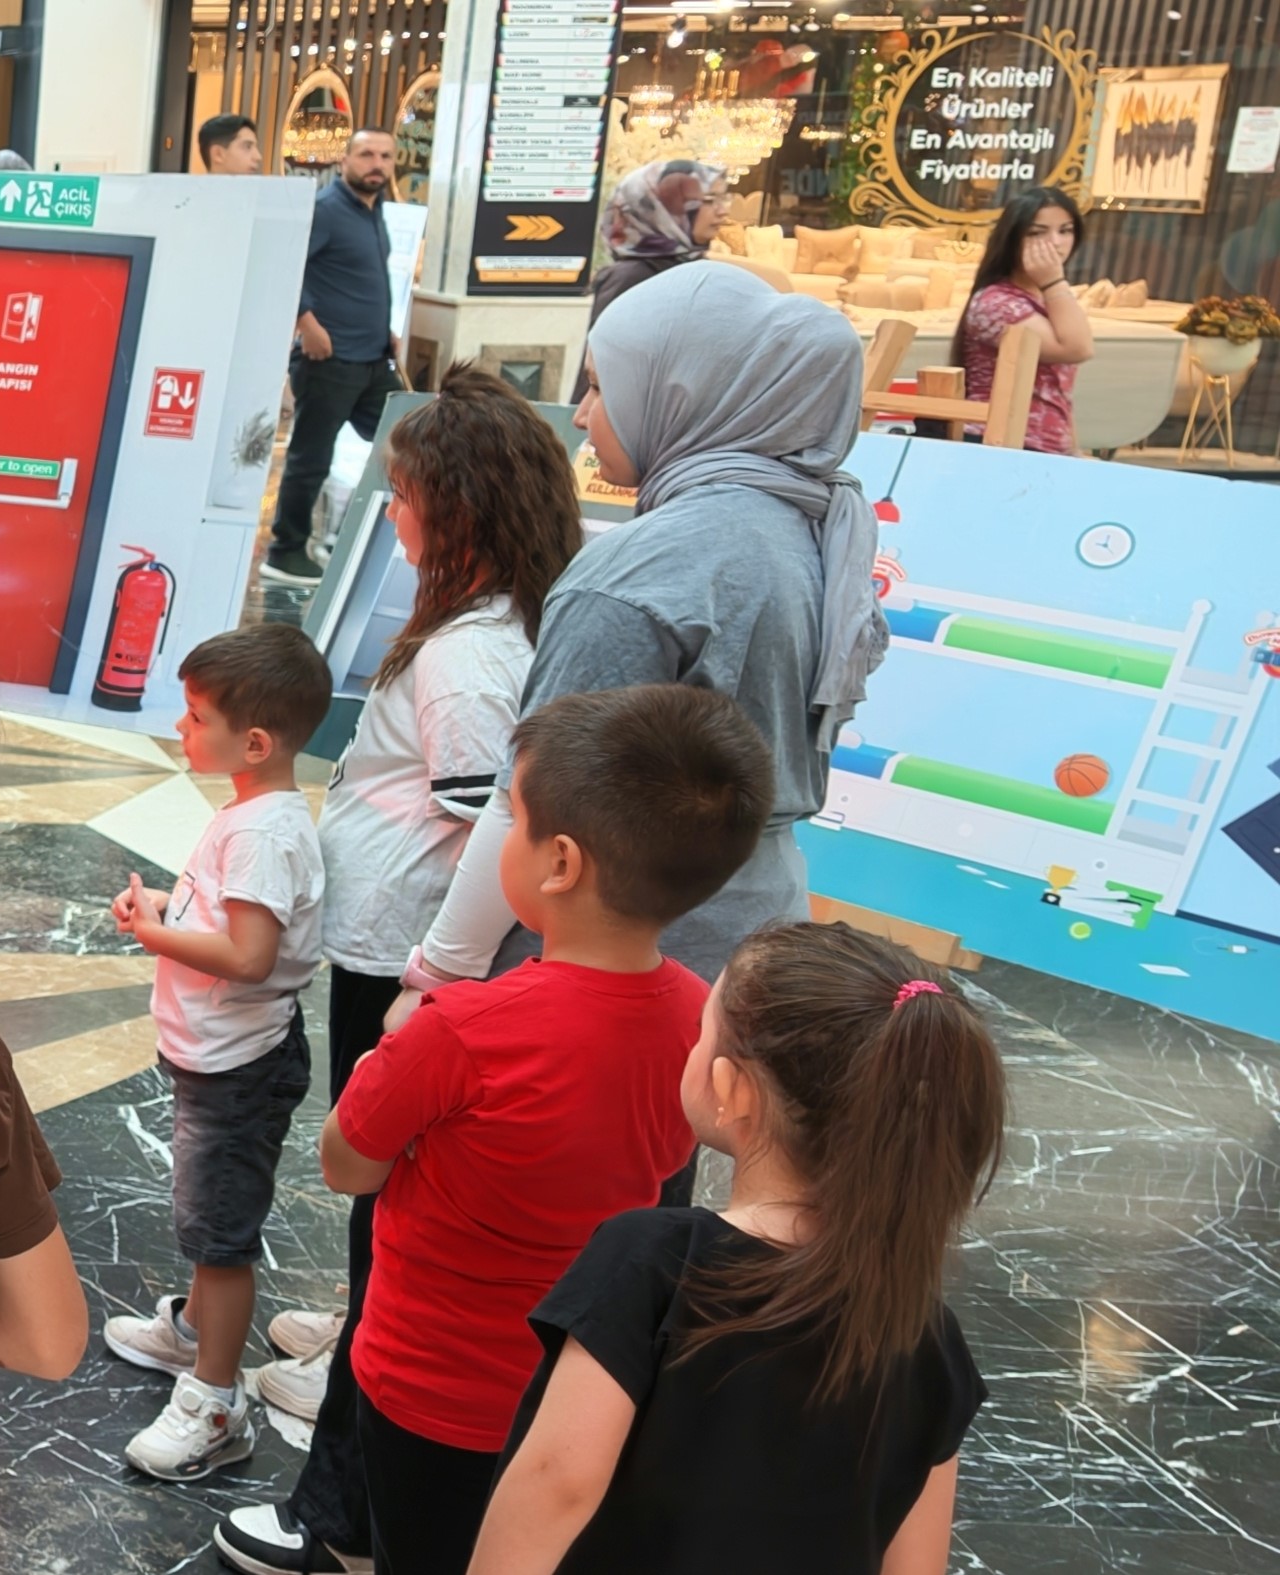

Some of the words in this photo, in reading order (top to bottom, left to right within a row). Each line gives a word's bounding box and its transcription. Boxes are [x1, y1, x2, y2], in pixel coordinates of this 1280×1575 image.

[931, 67, 963, 88] En
[969, 66, 1054, 88] Kaliteli
[942, 94, 1034, 119] Ürünler
[910, 129, 942, 149] En
[947, 128, 1055, 154] Avantajlı
[920, 158, 1035, 184] Fiyatlarla
[59, 186, 91, 202] ACİL
[54, 202, 92, 219] ÇIKIŞ
[8, 460, 20, 471] to
[23, 463, 53, 475] open
